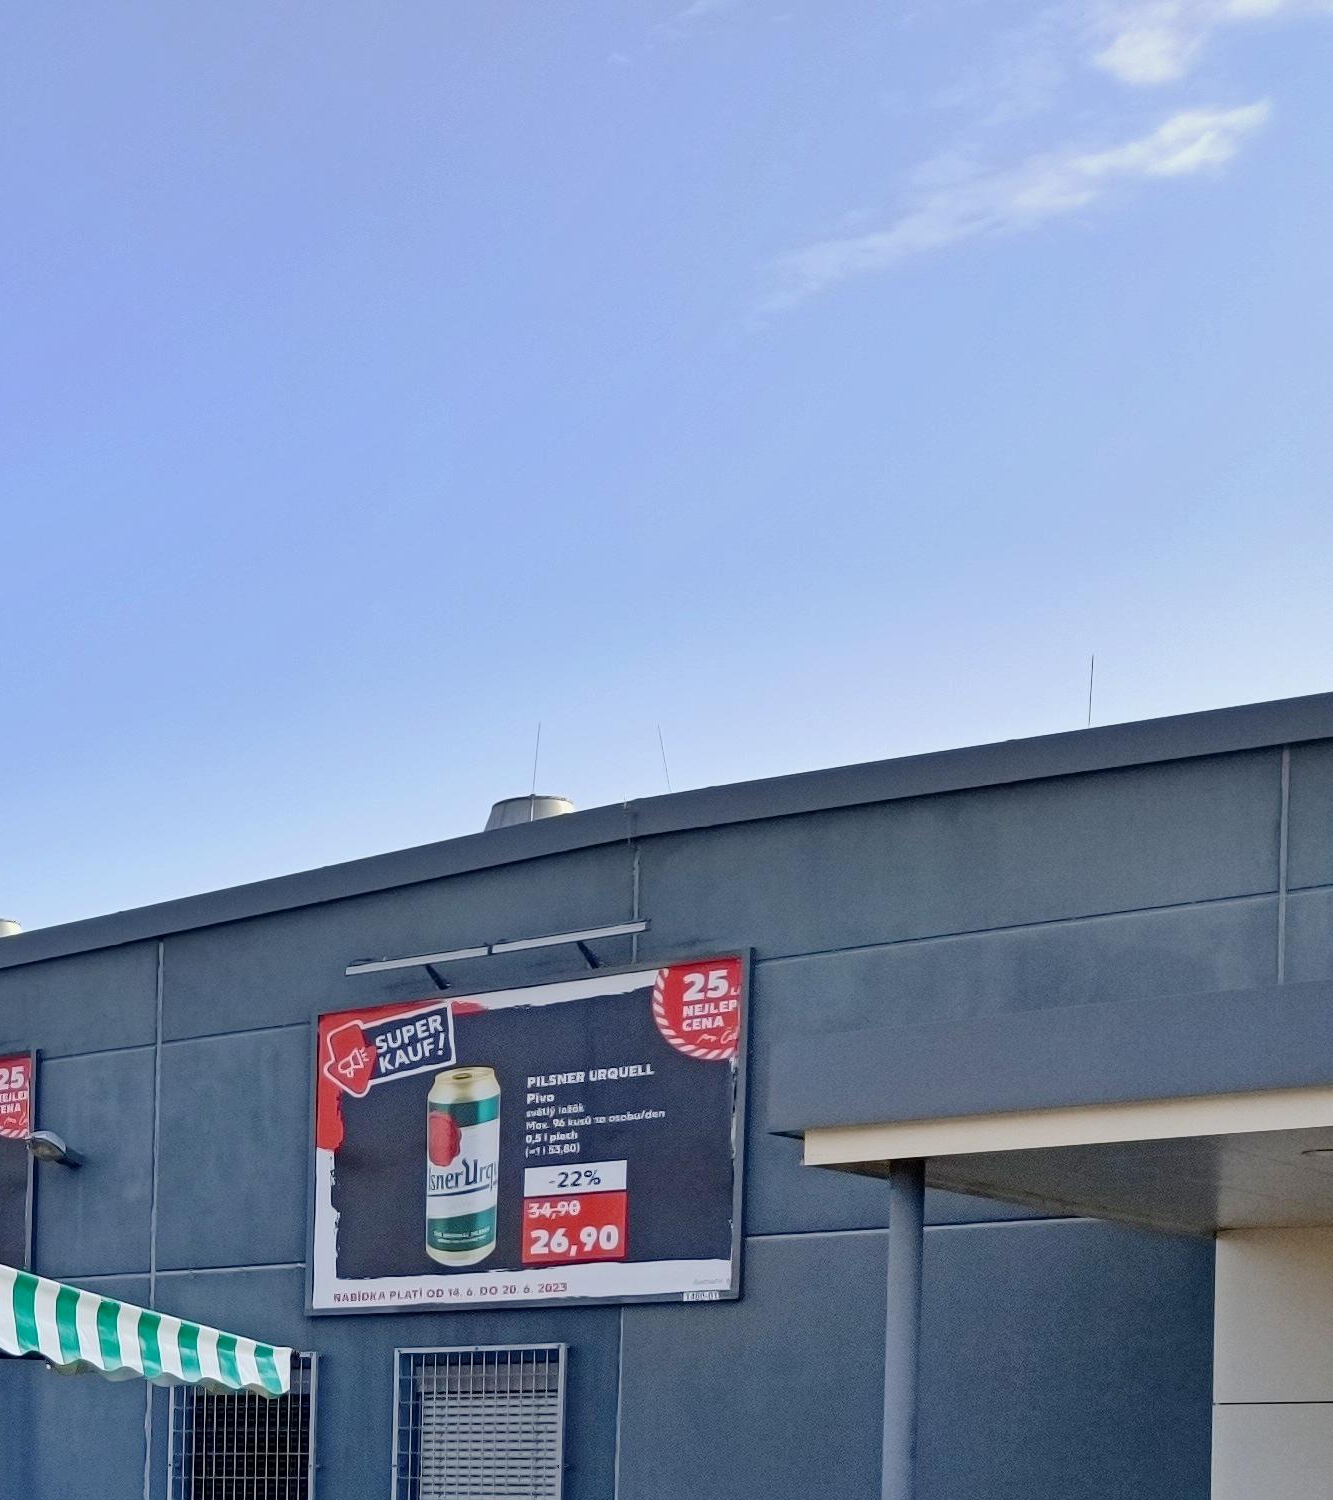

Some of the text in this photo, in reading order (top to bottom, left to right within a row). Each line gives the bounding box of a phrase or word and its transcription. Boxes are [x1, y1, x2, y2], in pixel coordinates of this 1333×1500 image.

[683, 969, 729, 1002] 25
[375, 1014, 443, 1054] SUPER
[682, 1016, 725, 1032] CENA
[379, 1032, 445, 1074] KAUF!
[527, 1063, 655, 1089] PILSNER URQUELL
[526, 1092, 555, 1105] Pivo
[548, 1169, 601, 1188] -22%
[530, 1224, 619, 1257] 26,90
[333, 1290, 386, 1303] NABÍDKA
[389, 1287, 423, 1300] PLATÍ
[426, 1286, 445, 1298] OD
[480, 1285, 499, 1296] DO
[537, 1282, 568, 1293] 2023
